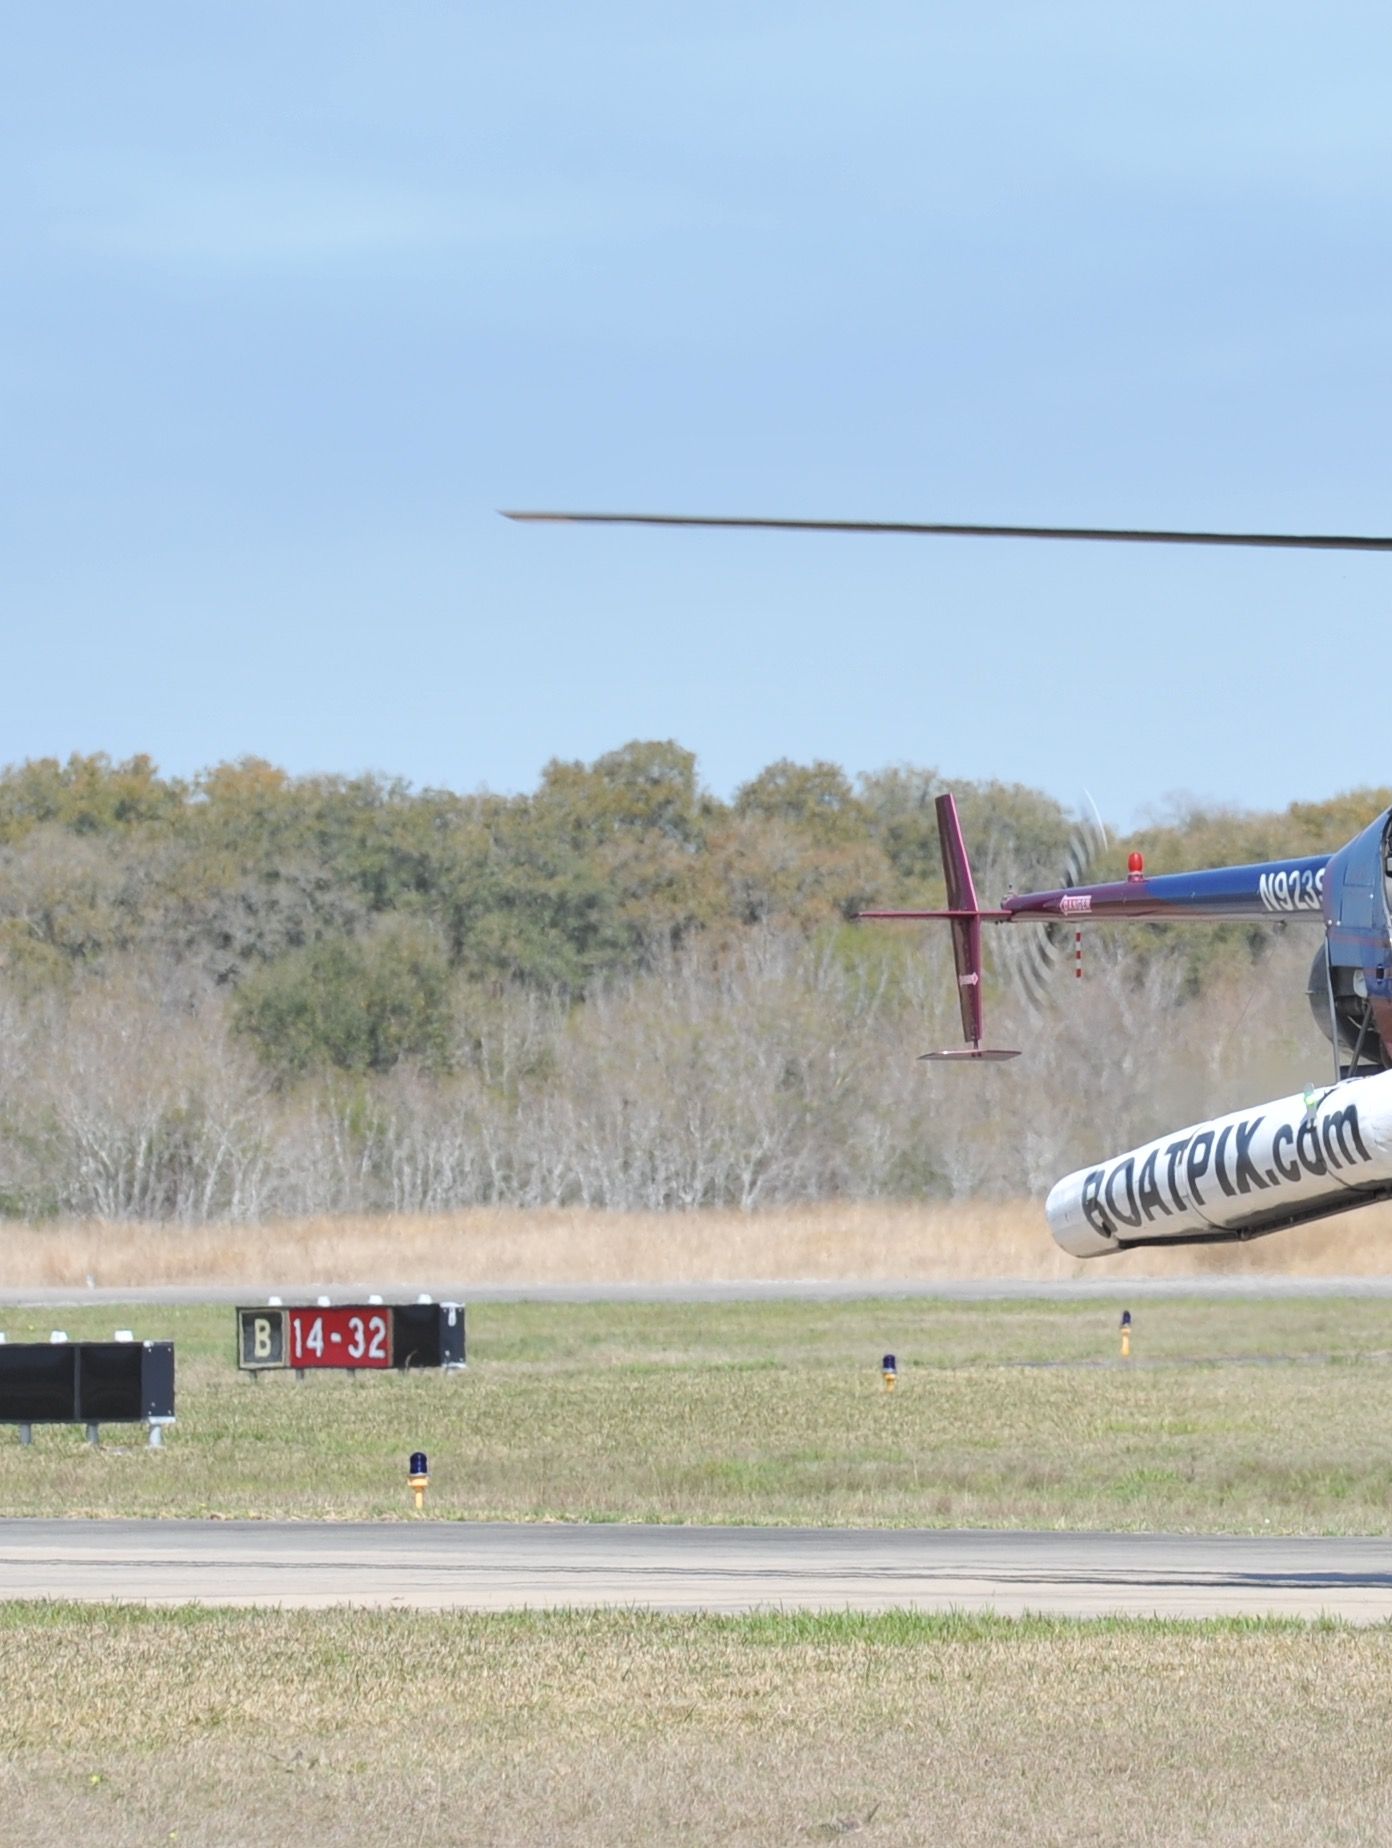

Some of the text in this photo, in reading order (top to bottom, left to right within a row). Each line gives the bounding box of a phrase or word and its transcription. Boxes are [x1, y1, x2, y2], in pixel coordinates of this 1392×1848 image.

[1081, 1103, 1372, 1239] BOATPIX.com
[254, 1316, 387, 1359] B 14-32
